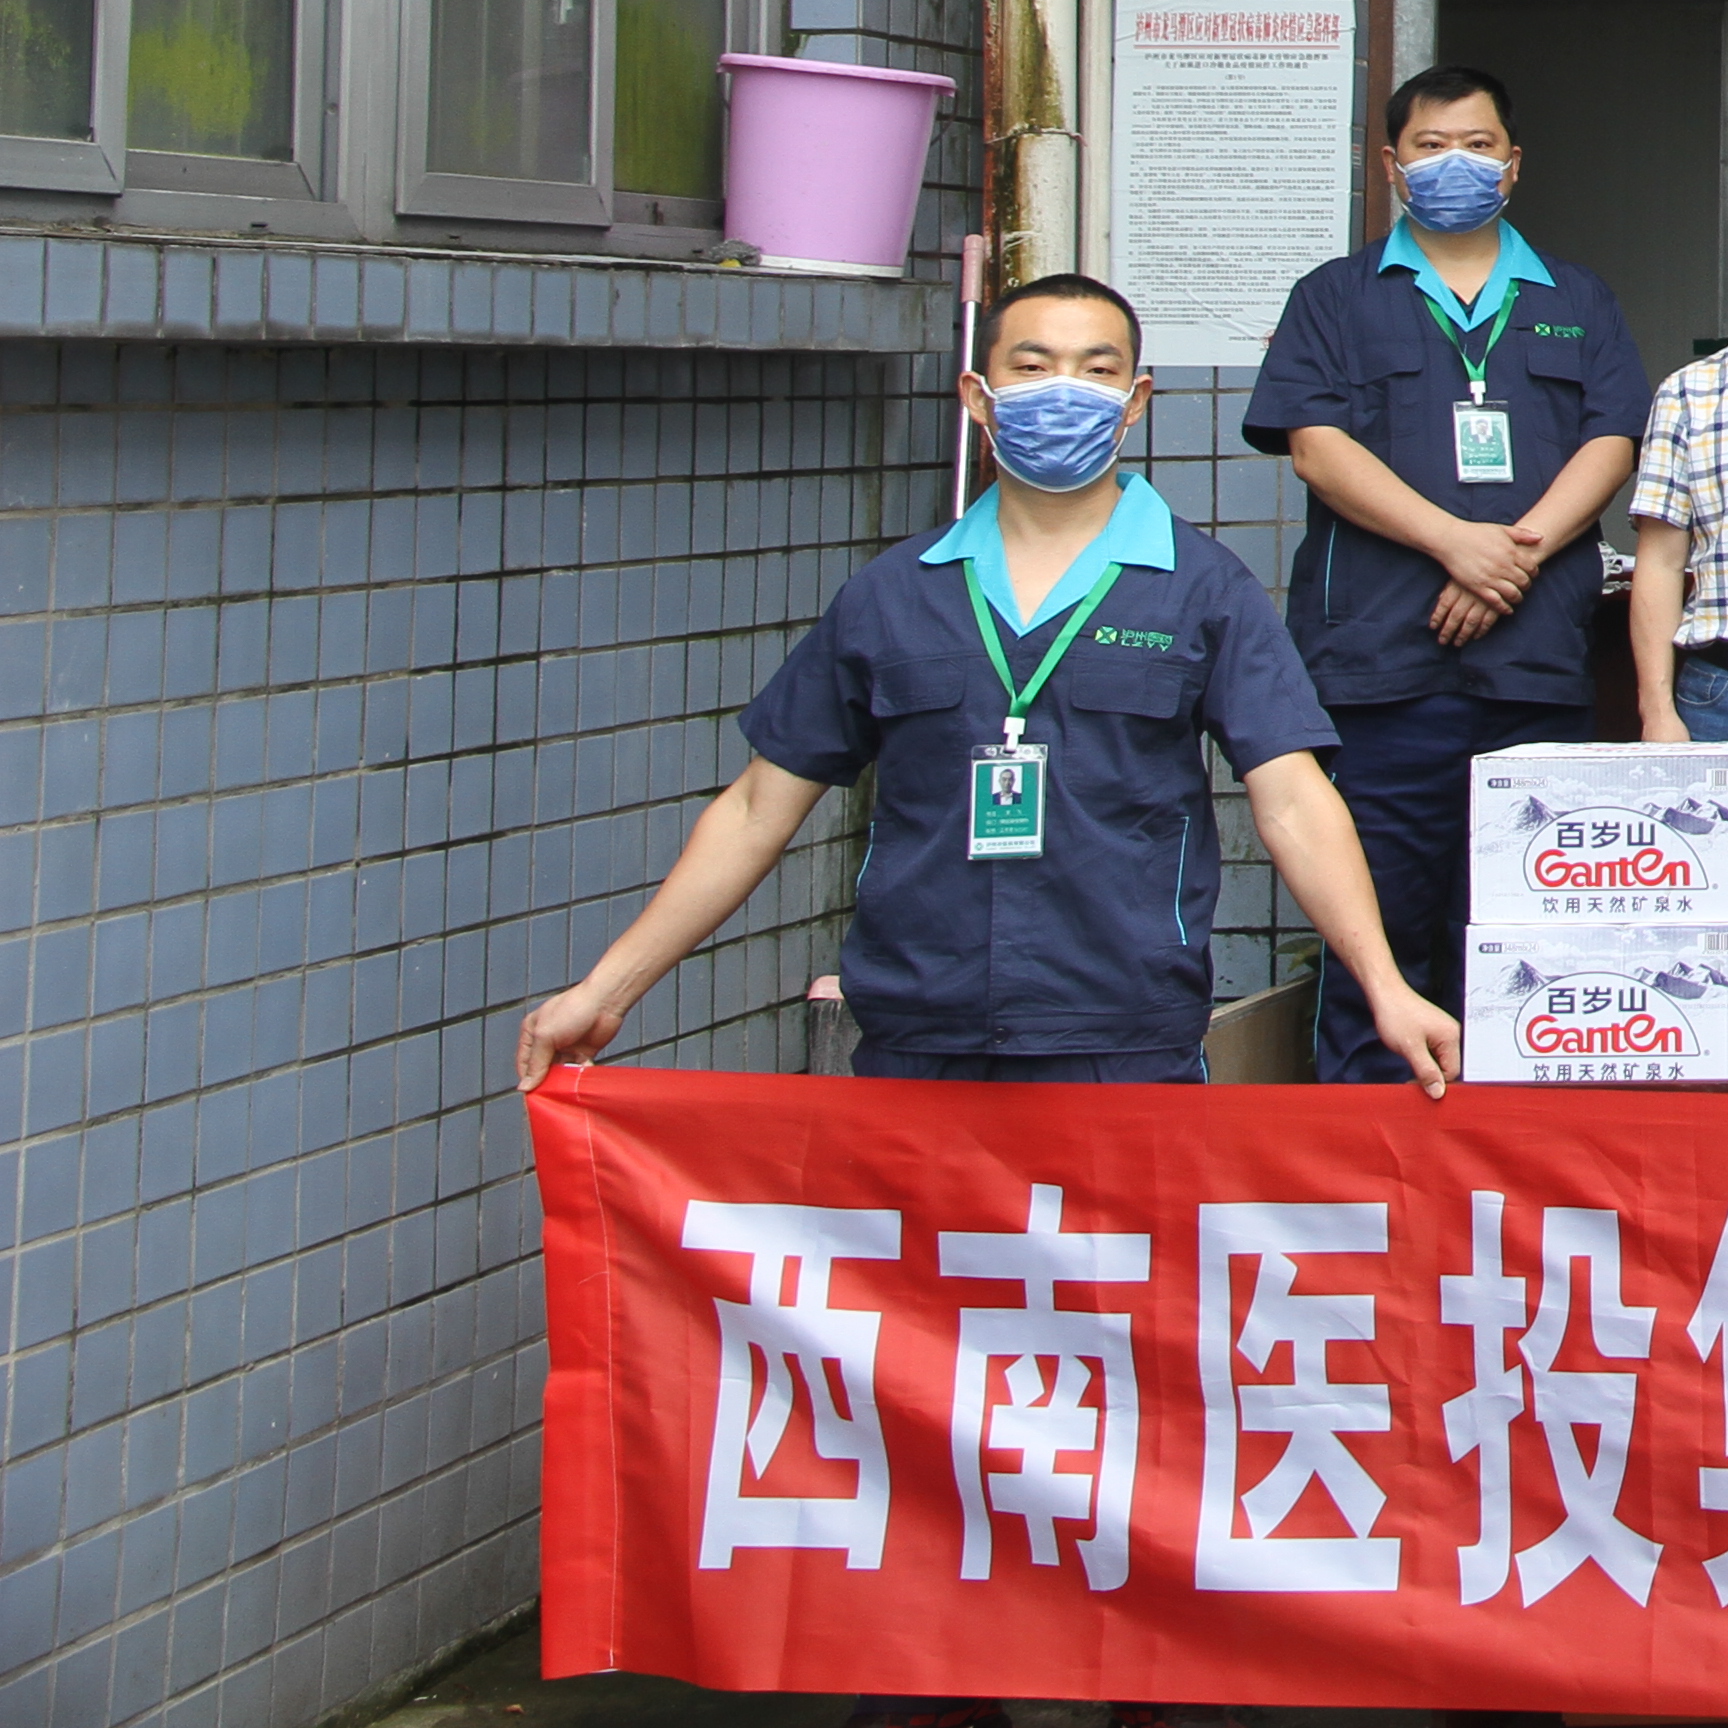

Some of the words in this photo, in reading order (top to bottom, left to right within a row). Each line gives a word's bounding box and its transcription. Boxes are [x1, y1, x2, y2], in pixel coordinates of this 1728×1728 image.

[1557, 820, 1656, 849] 百岁山
[1542, 896, 1694, 913] 饮用天然矿泉水
[1548, 986, 1647, 1014] 百岁山
[1533, 1062, 1685, 1081] 饮用天然矿泉水
